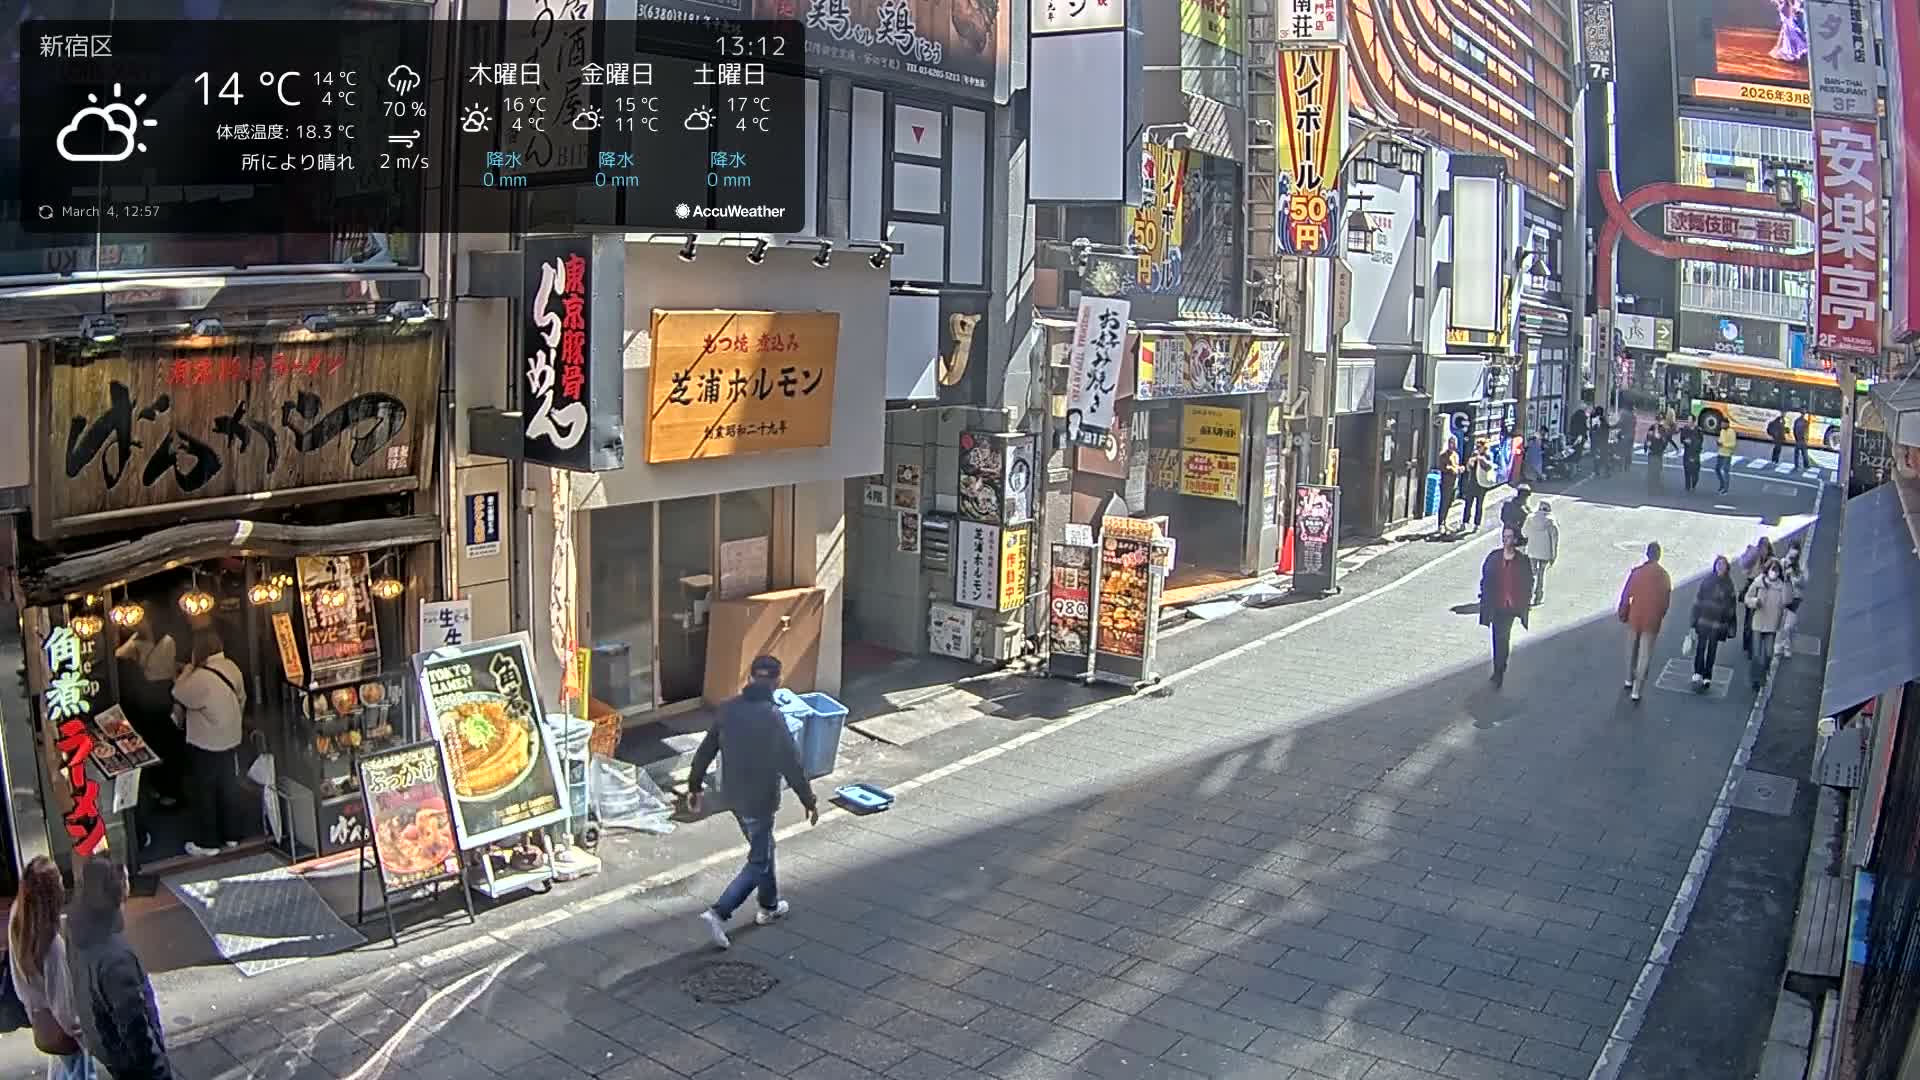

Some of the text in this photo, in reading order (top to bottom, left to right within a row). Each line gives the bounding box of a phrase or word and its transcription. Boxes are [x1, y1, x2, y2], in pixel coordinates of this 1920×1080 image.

[1590, 63, 1610, 79] 7F
[1296, 55, 1322, 192] ハイボール
[1290, 197, 1328, 222] 50
[1296, 224, 1320, 251] 円
[1820, 127, 1876, 330] 安楽亭
[561, 252, 585, 400] 東京豚骨
[703, 332, 800, 354] もつ焼 煮込み
[1819, 333, 1837, 347] 2F
[1085, 308, 1121, 413] お好み焼き
[669, 366, 824, 406] 芝浦ホルモン
[429, 664, 472, 683] TOKYO
[431, 676, 474, 695] RAMEN
